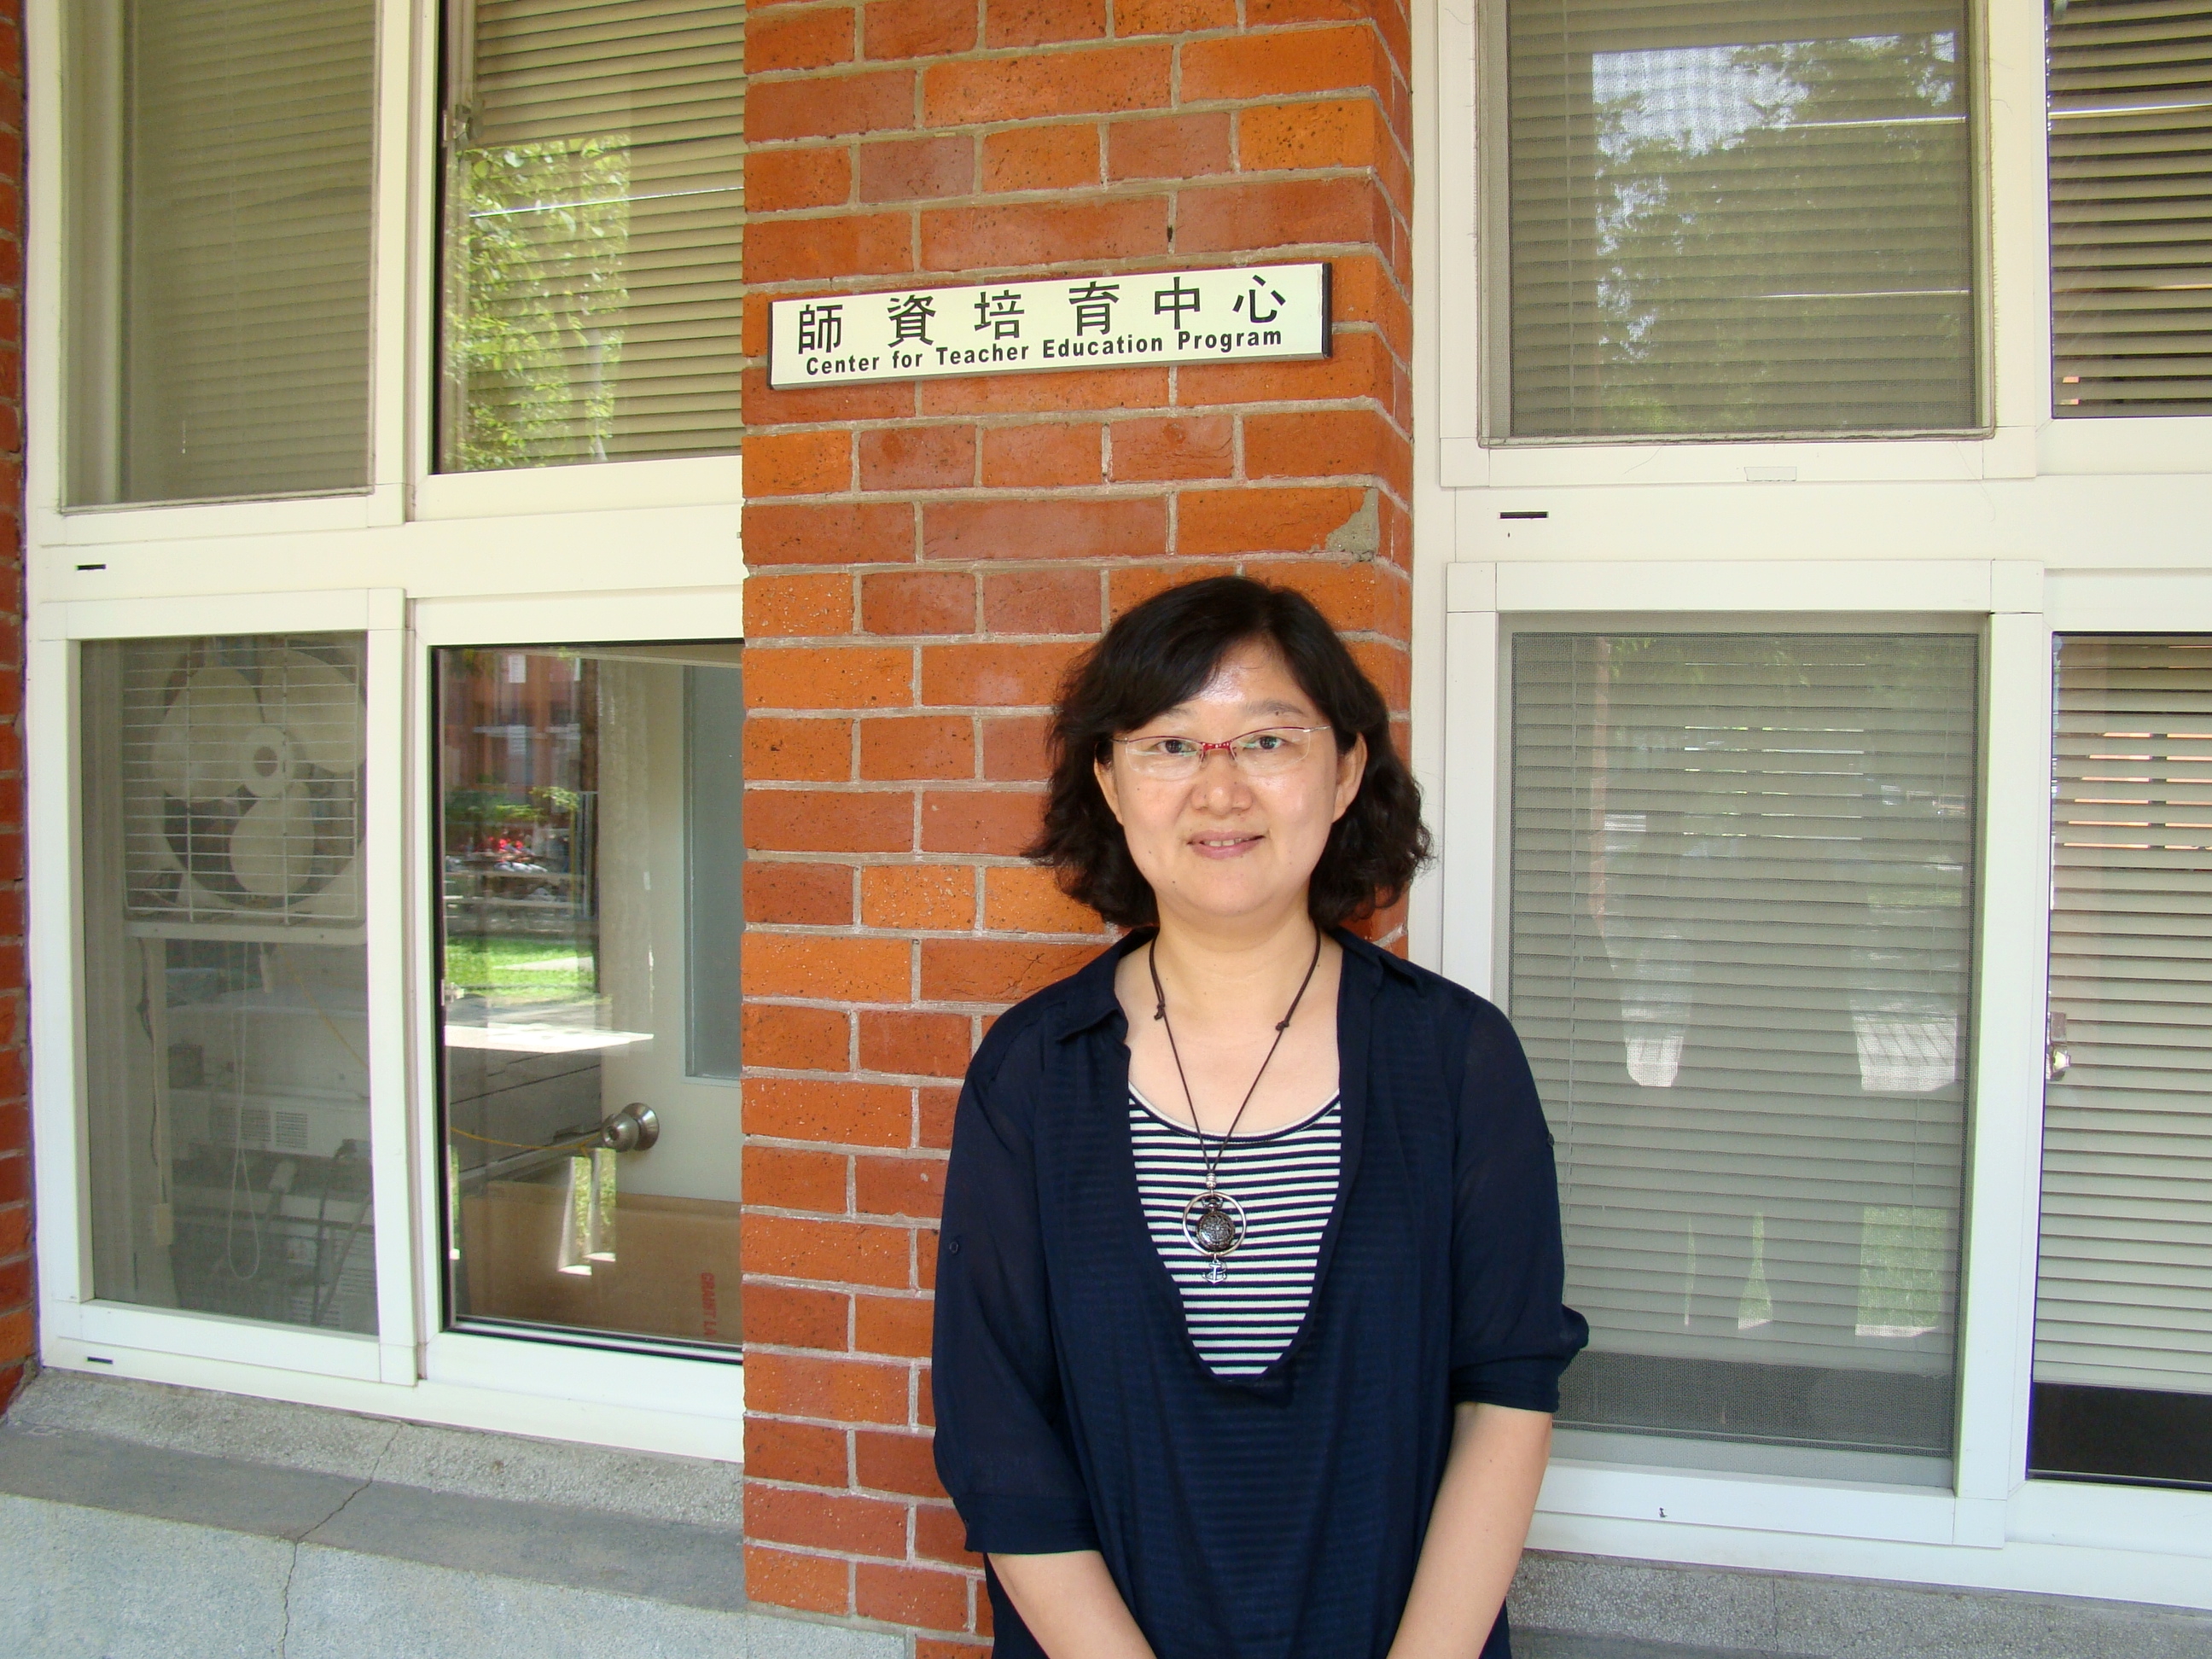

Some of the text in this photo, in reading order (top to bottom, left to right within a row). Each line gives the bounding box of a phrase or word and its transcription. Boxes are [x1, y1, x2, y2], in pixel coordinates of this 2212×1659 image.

[798, 274, 1286, 354] 師資培育中心
[806, 330, 1283, 375] Center for Teacher Education Program
